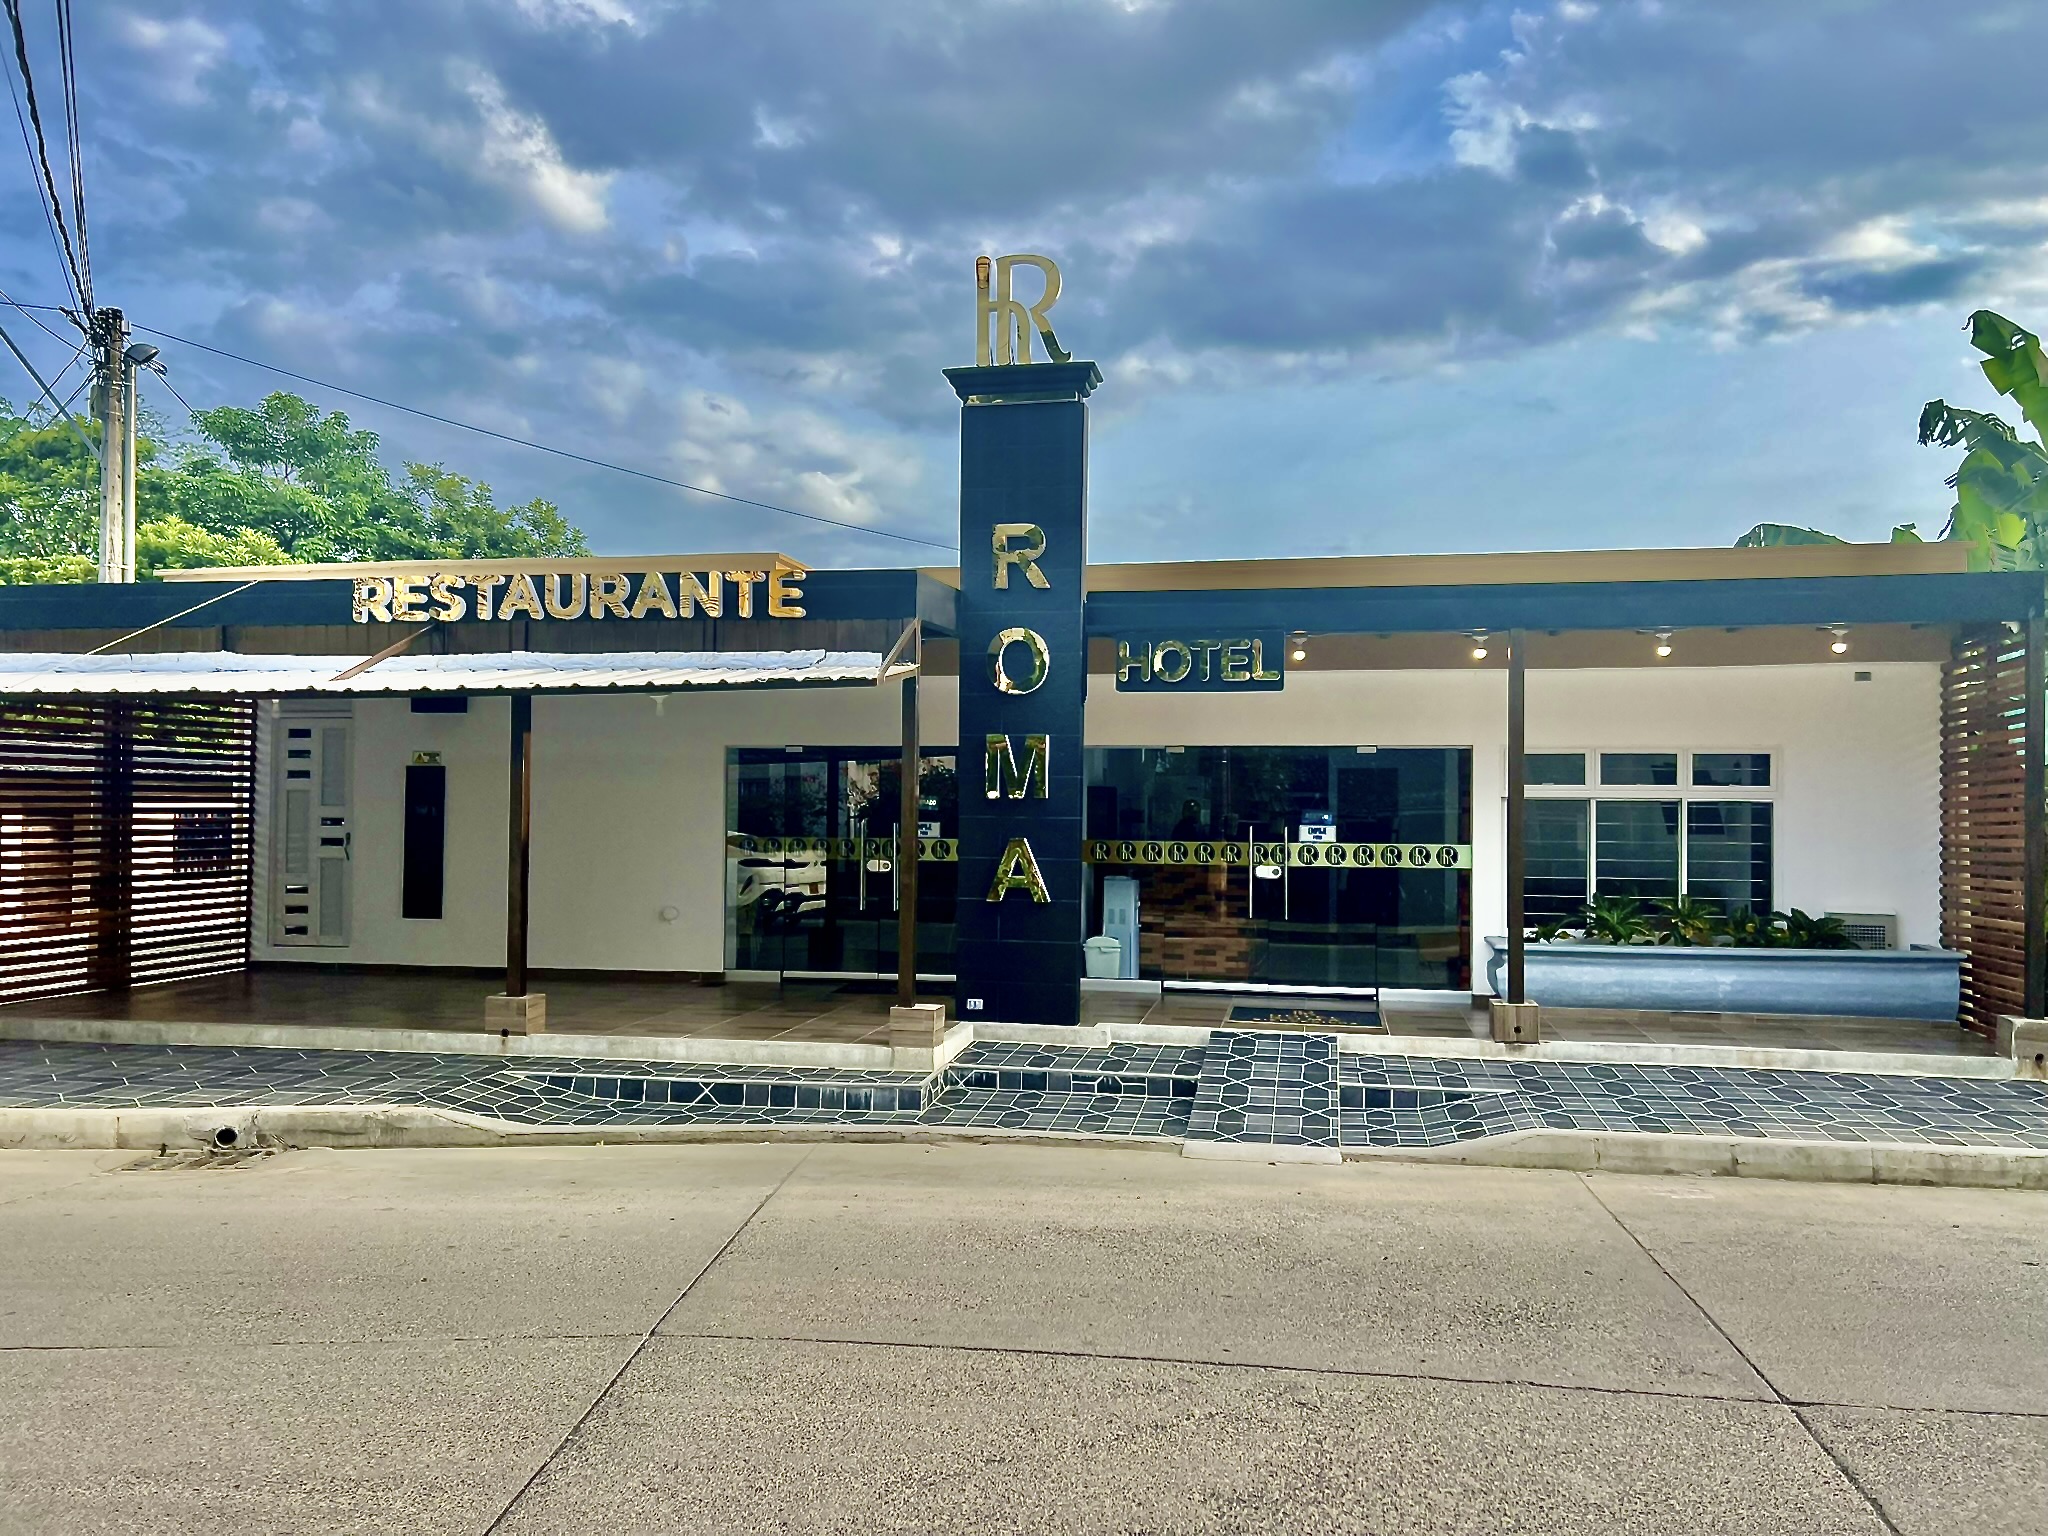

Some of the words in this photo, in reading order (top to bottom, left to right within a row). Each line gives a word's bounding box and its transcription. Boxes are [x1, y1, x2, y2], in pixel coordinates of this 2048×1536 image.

[352, 569, 807, 623] RESTAURANTE
[1118, 638, 1281, 682] HOTEL
[985, 523, 1052, 902] ROMA
